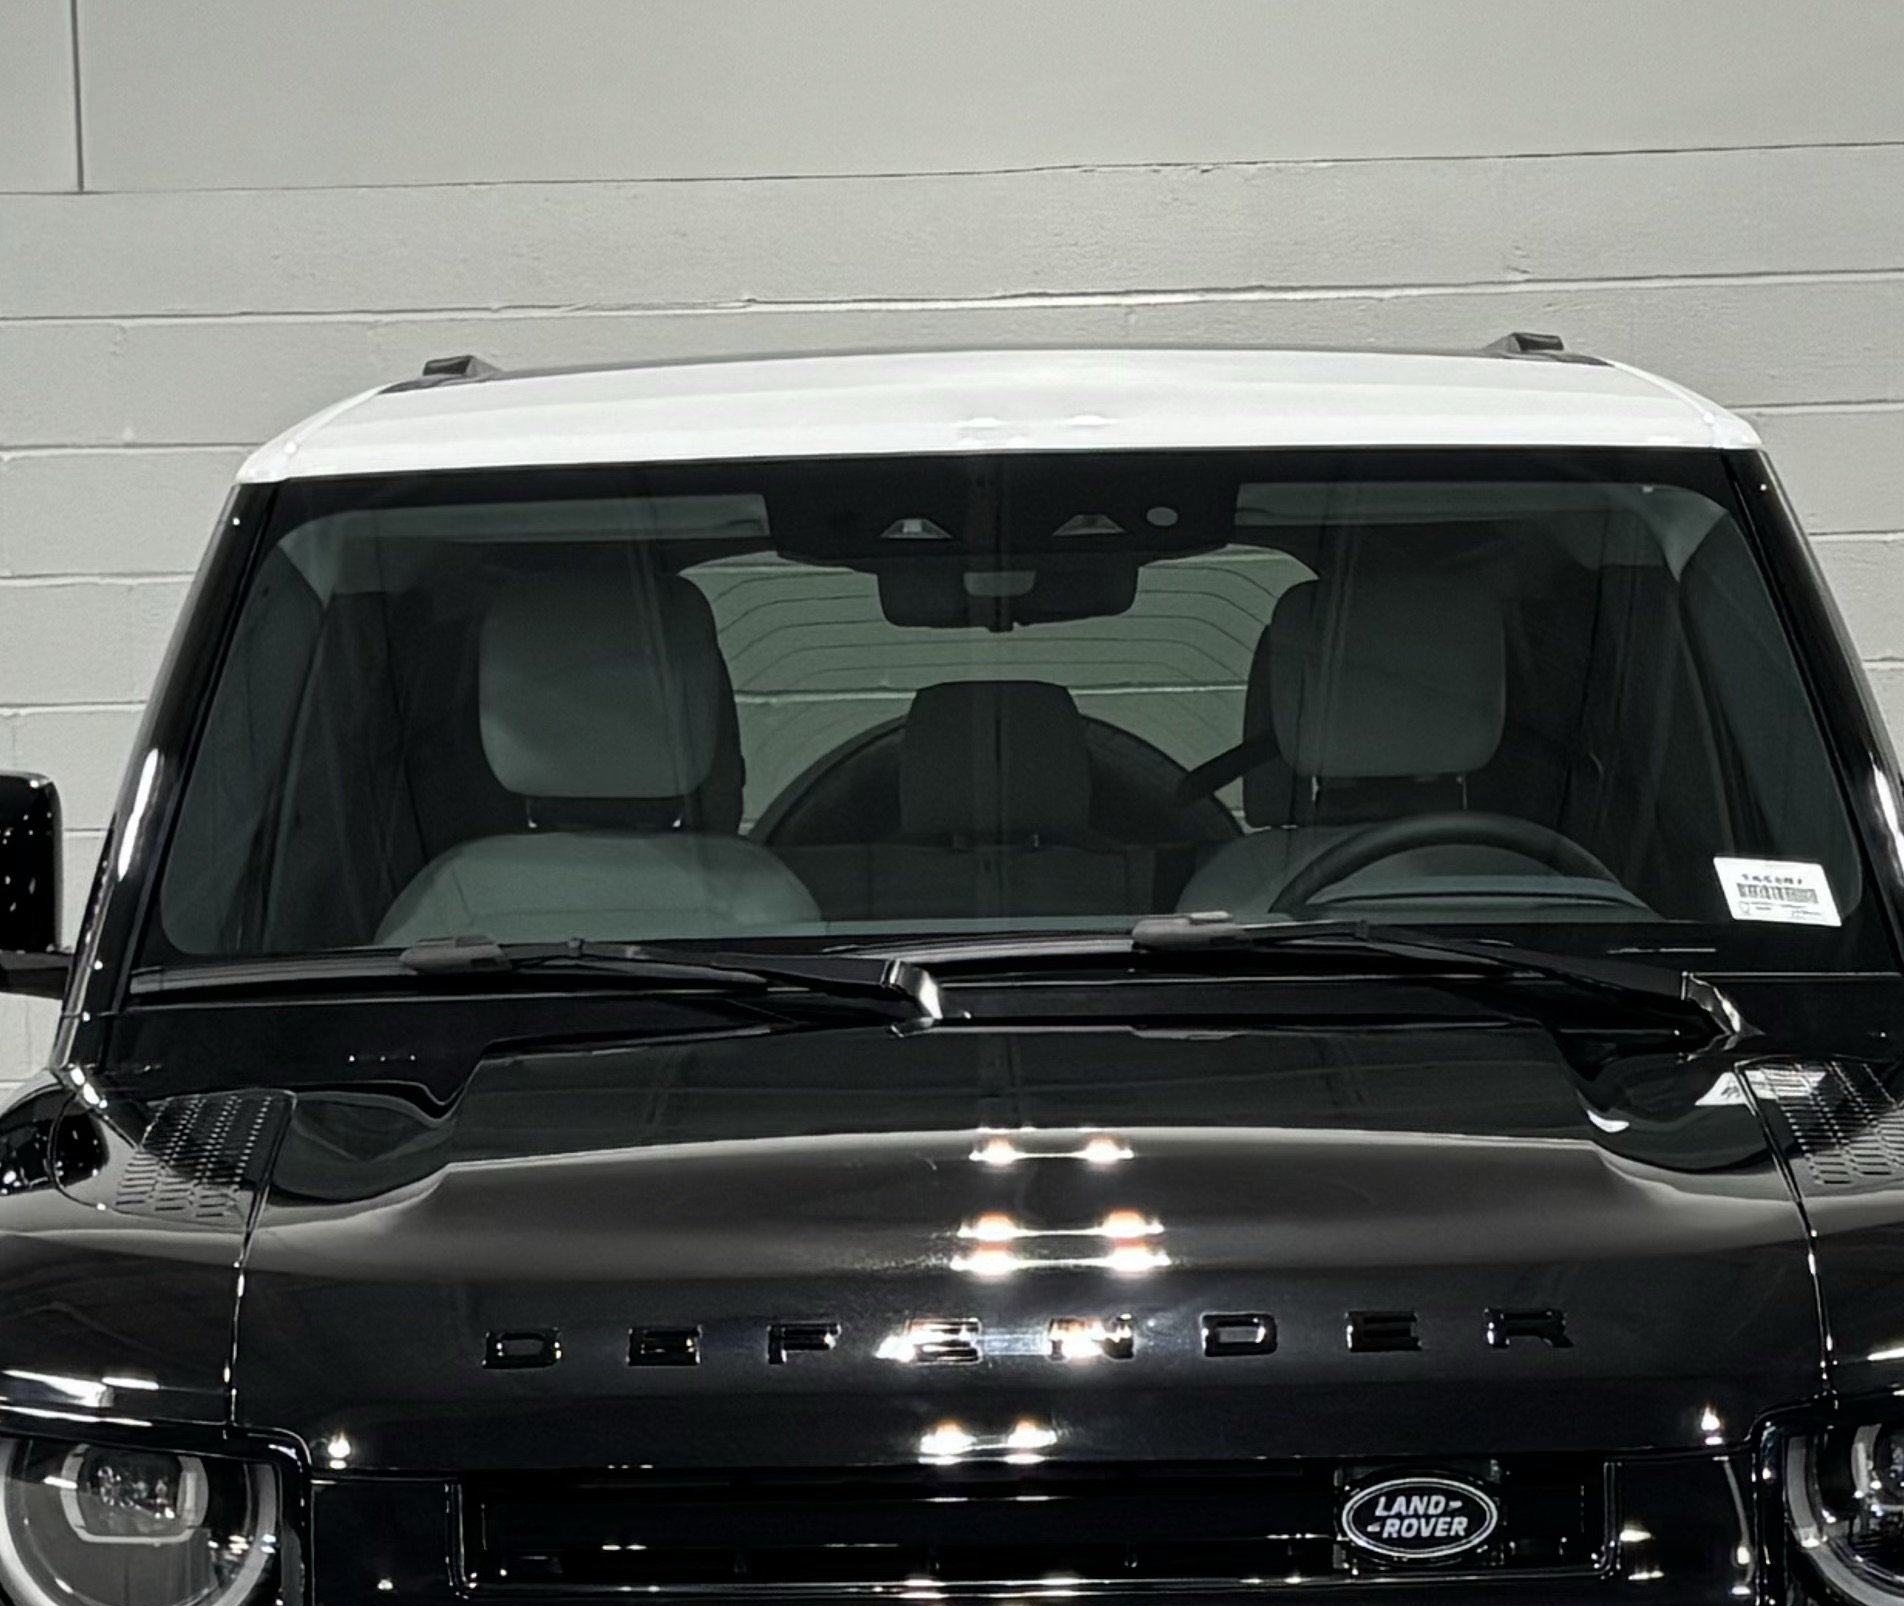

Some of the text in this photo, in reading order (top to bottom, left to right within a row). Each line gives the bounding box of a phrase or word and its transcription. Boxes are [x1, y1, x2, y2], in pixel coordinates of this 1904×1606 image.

[482, 1305, 1574, 1369] DEFENDER
[1374, 1494, 1447, 1517] LAND
[1381, 1516, 1469, 1539] ROVER
